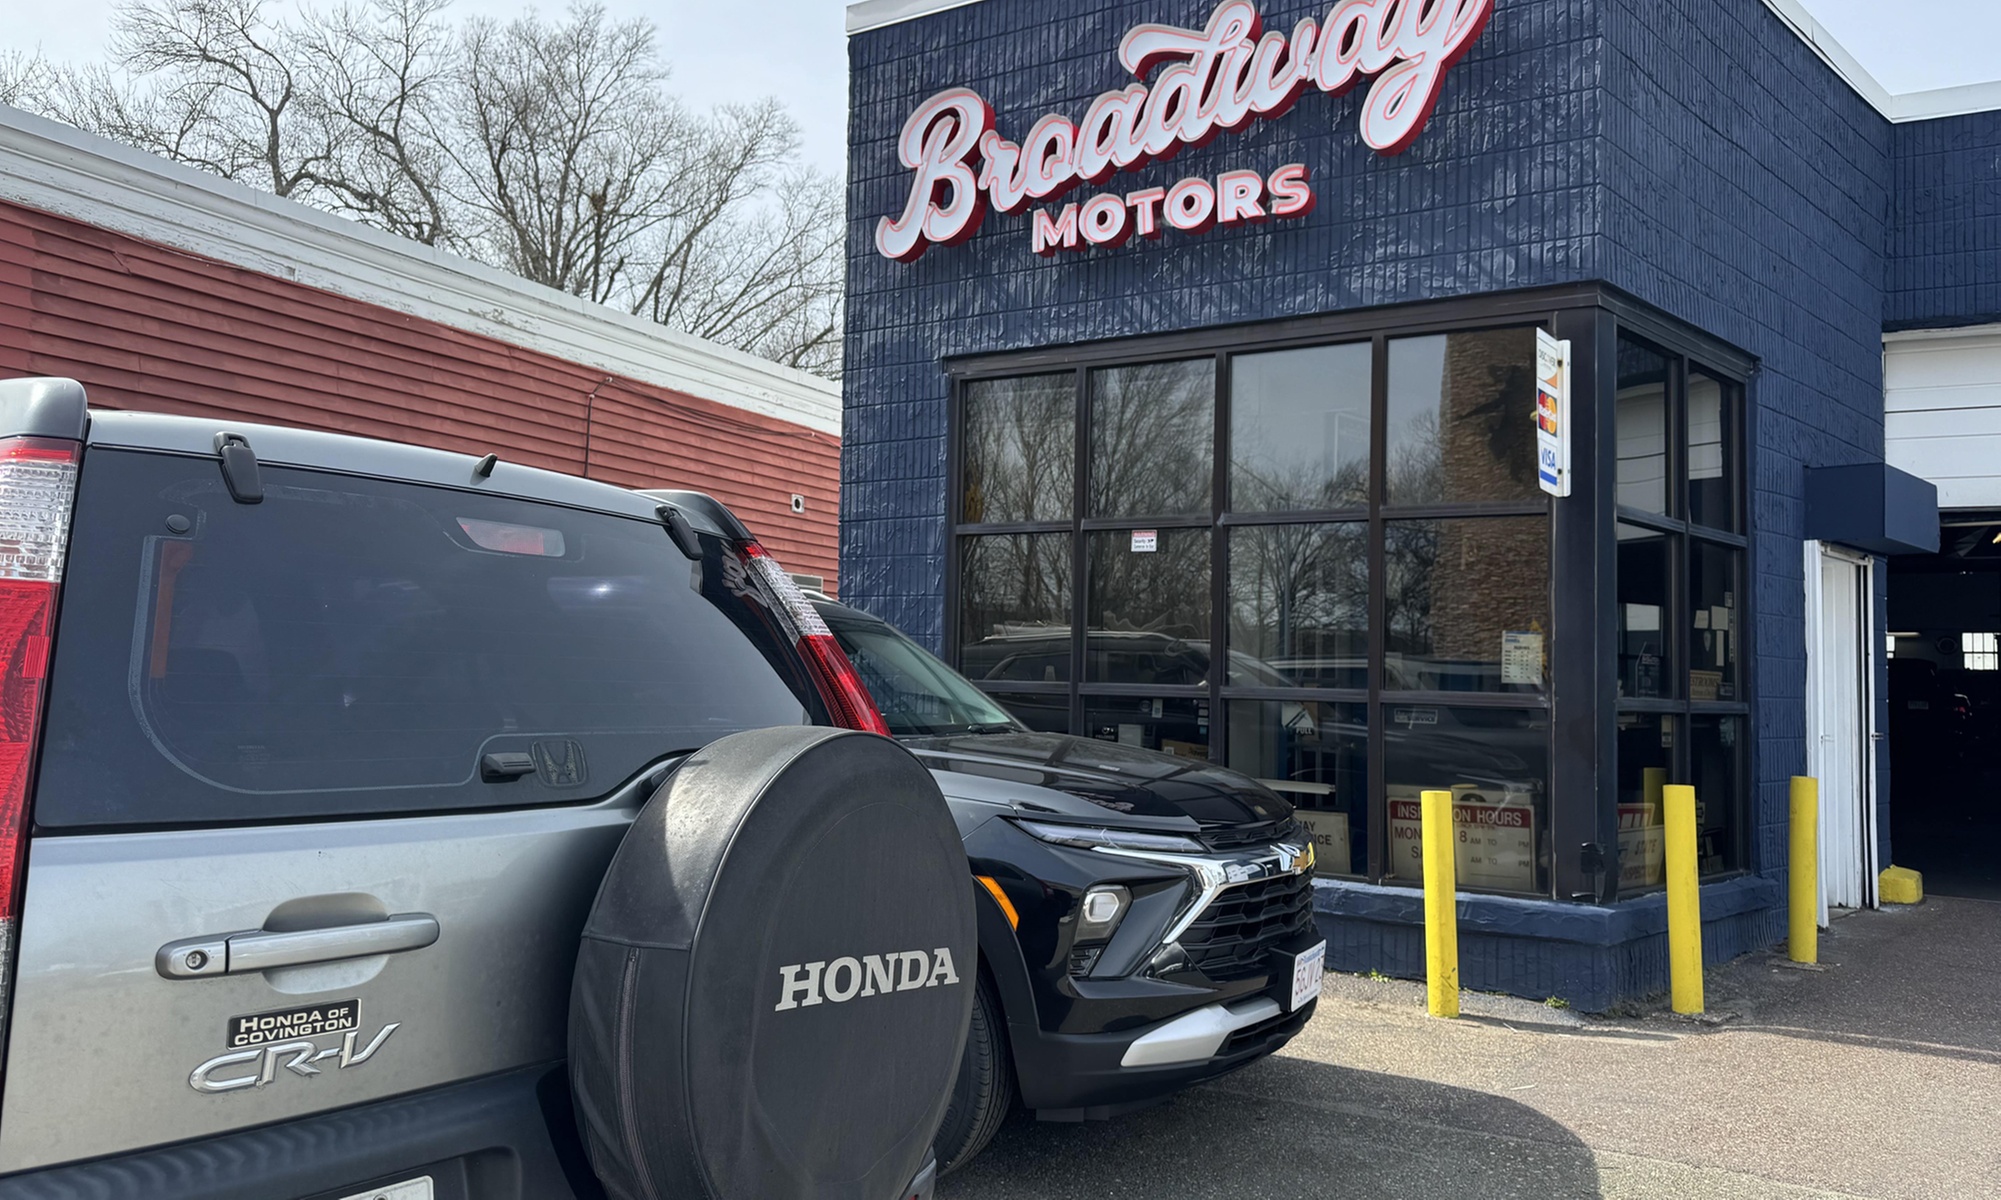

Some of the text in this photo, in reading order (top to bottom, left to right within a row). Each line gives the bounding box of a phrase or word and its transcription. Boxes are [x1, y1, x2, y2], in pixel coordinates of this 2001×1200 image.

[876, 0, 1490, 260] Broadway
[1032, 163, 1311, 255] MOTORS
[1541, 447, 1556, 470] VISA
[1476, 810, 1522, 826] HOURS
[1459, 830, 1467, 843] 8
[1487, 838, 1497, 846] TO
[1488, 857, 1497, 865] TO
[775, 947, 960, 1012] HONDA
[234, 1017, 352, 1046] COVINGTON
[240, 1007, 349, 1033] HONDA OF
[189, 1021, 402, 1094] CR-V
